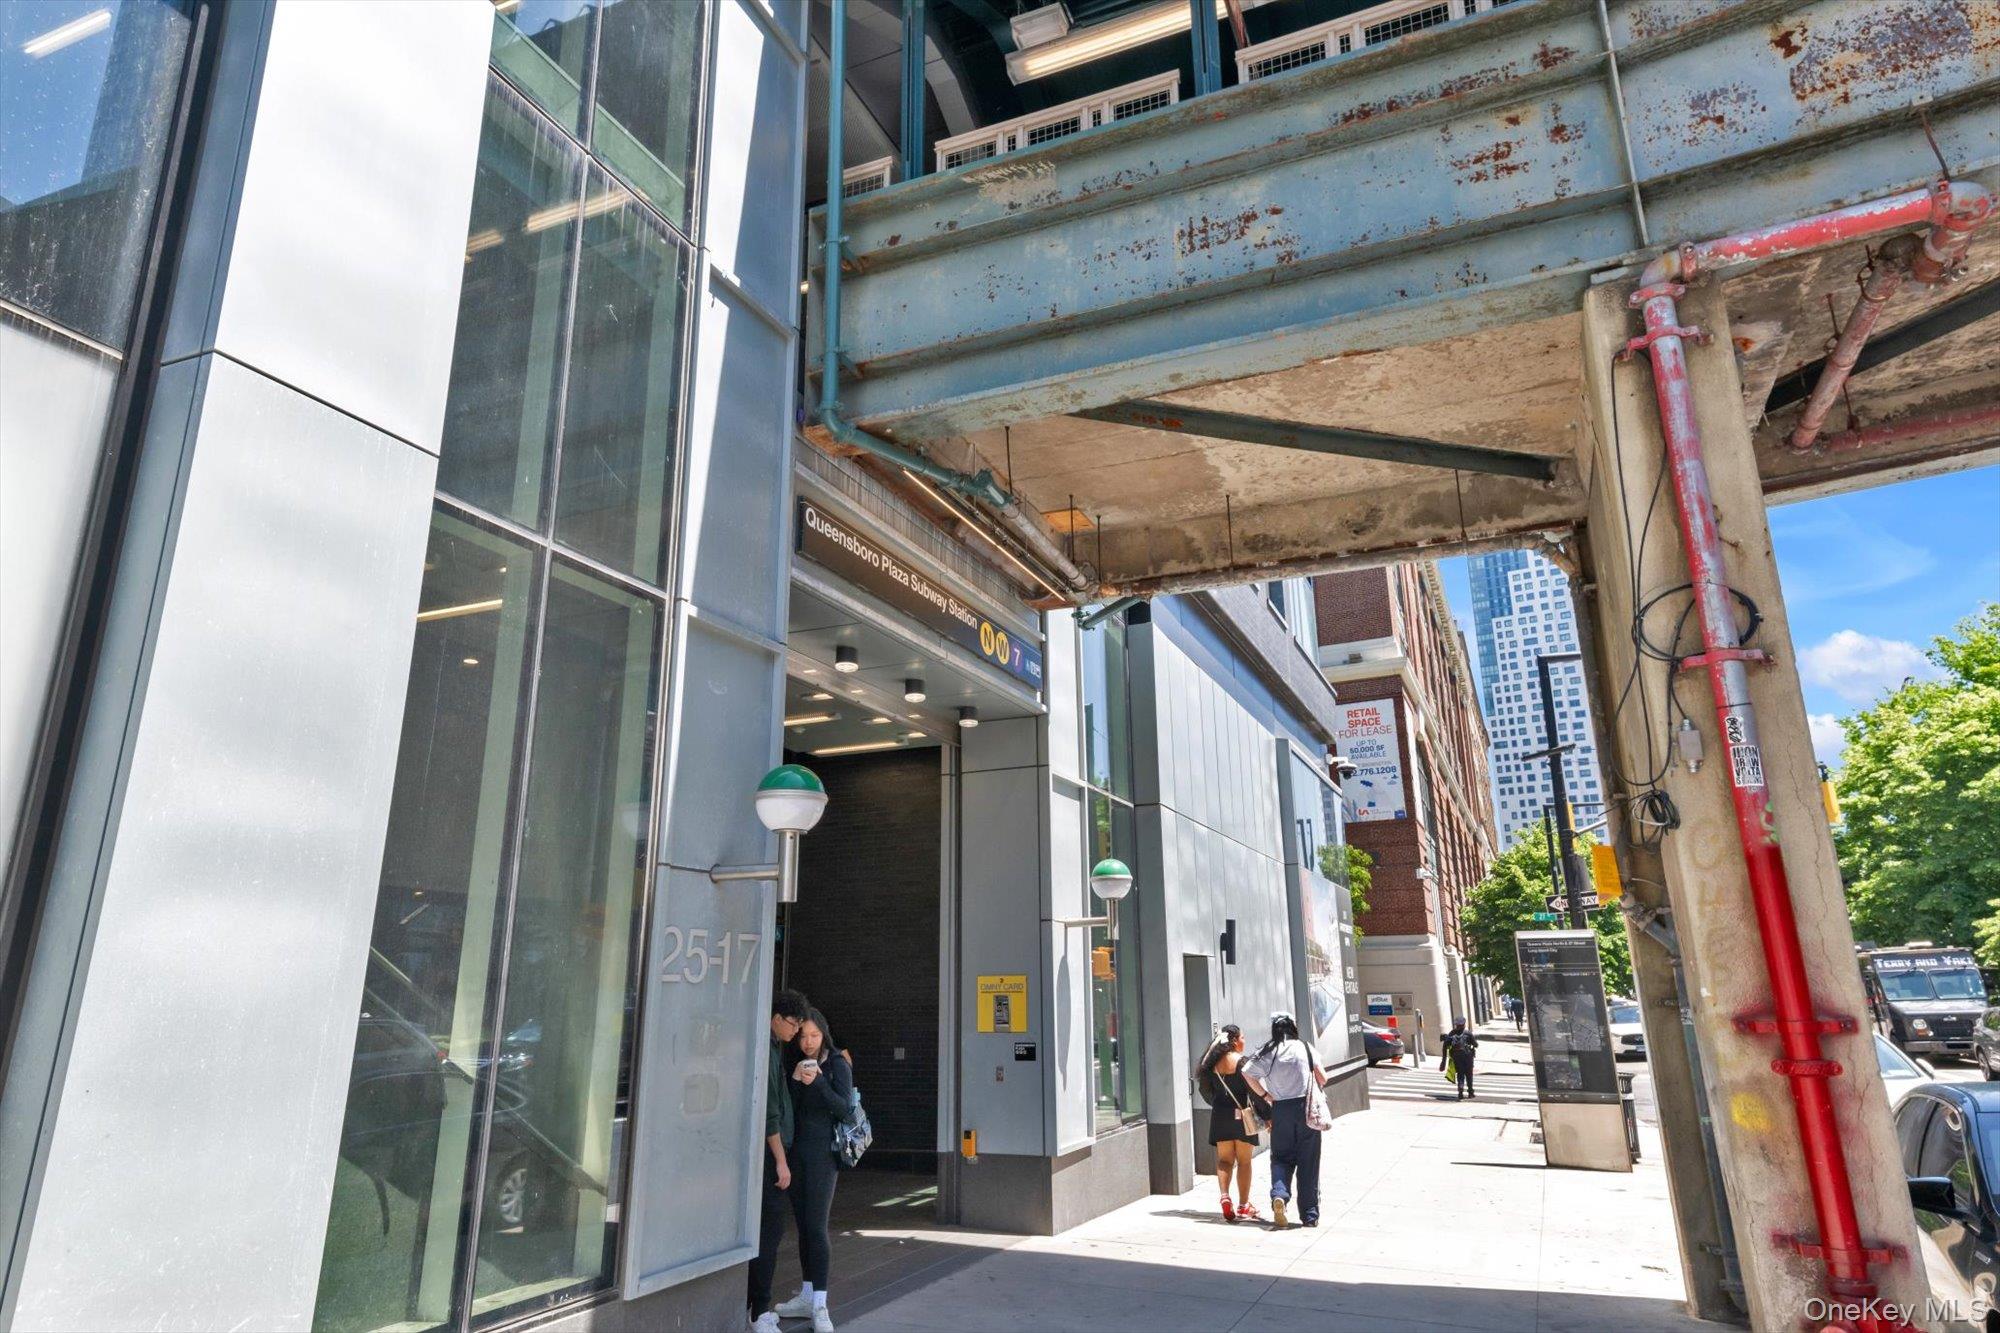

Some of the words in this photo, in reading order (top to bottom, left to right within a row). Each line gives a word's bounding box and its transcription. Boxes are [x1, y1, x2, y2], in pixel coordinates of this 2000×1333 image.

[805, 507, 880, 568] Queensboro
[881, 555, 909, 587] Plaza
[910, 574, 948, 613] Subway
[948, 600, 978, 630] Station
[1347, 707, 1380, 719] RETAIL
[1348, 717, 1381, 729] SPACE
[1338, 729, 1358, 740] FOR
[1361, 725, 1393, 738] LEASE
[1350, 751, 1387, 760] AVAILABLE
[660, 925, 761, 984] 25-17
[980, 982, 1002, 990] OMNY
[1003, 982, 1024, 990] CARD
